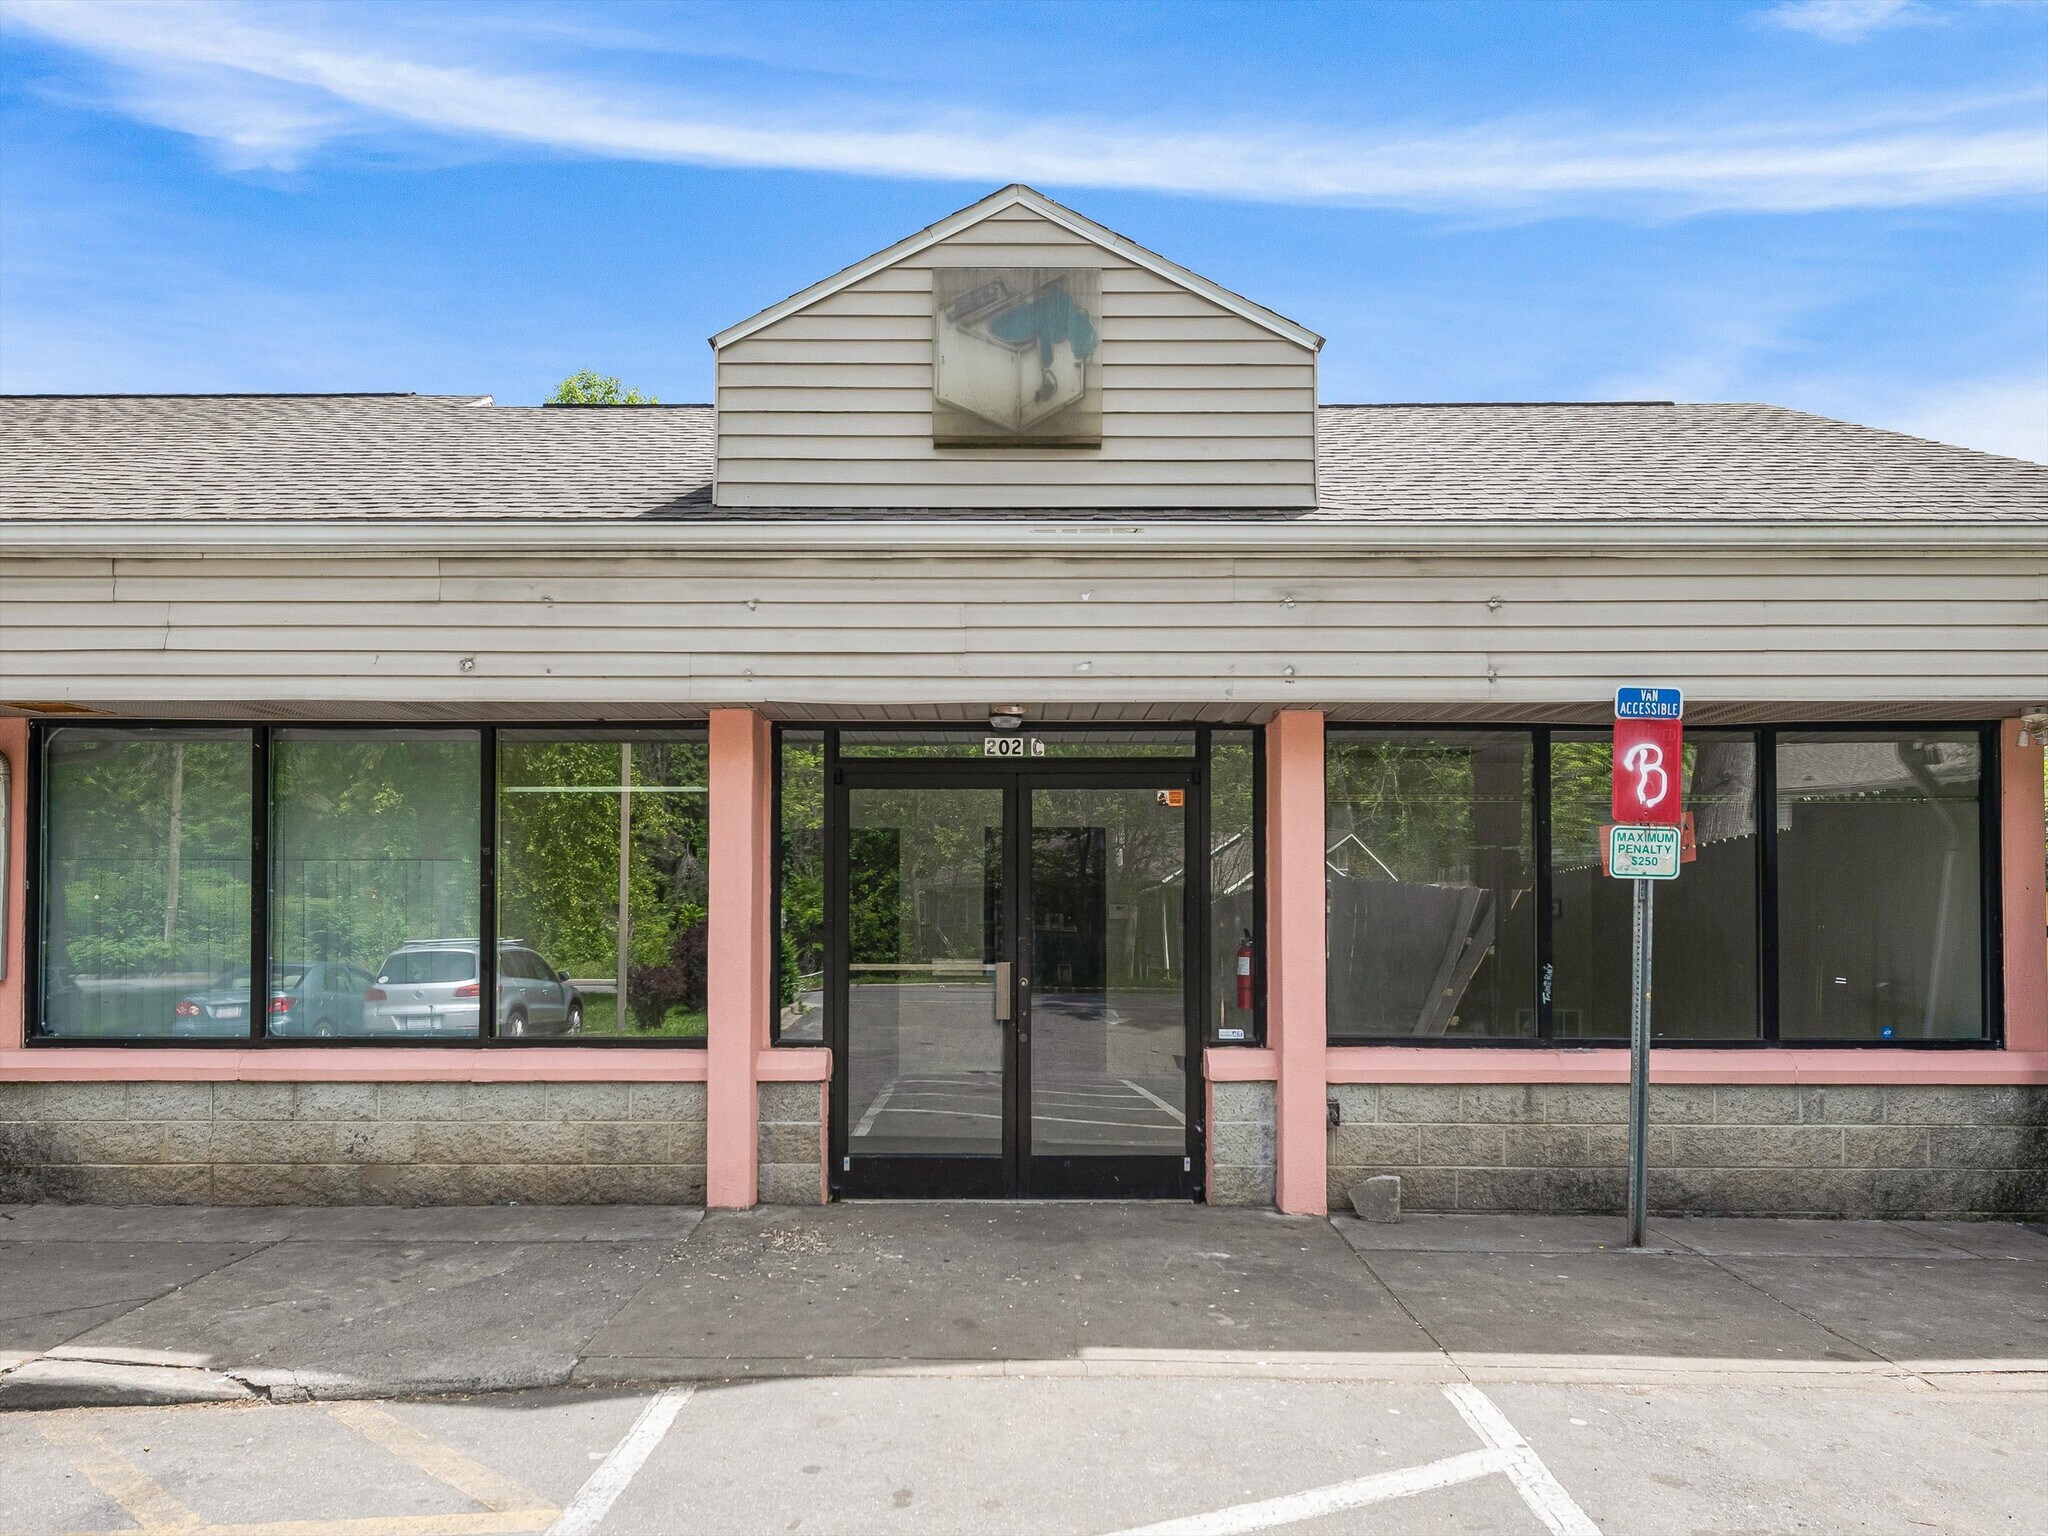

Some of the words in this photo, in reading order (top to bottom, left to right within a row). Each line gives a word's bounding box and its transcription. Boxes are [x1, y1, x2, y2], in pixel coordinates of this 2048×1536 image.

[1641, 689, 1659, 702] VAN
[1620, 702, 1678, 716] ACCESSIBLE
[986, 739, 1021, 755] 202
[1032, 739, 1043, 755] C
[1623, 743, 1668, 808] B
[1617, 833, 1674, 843] MAXIMUM
[1618, 844, 1672, 854] PENALTY
[1631, 856, 1658, 866] $250
